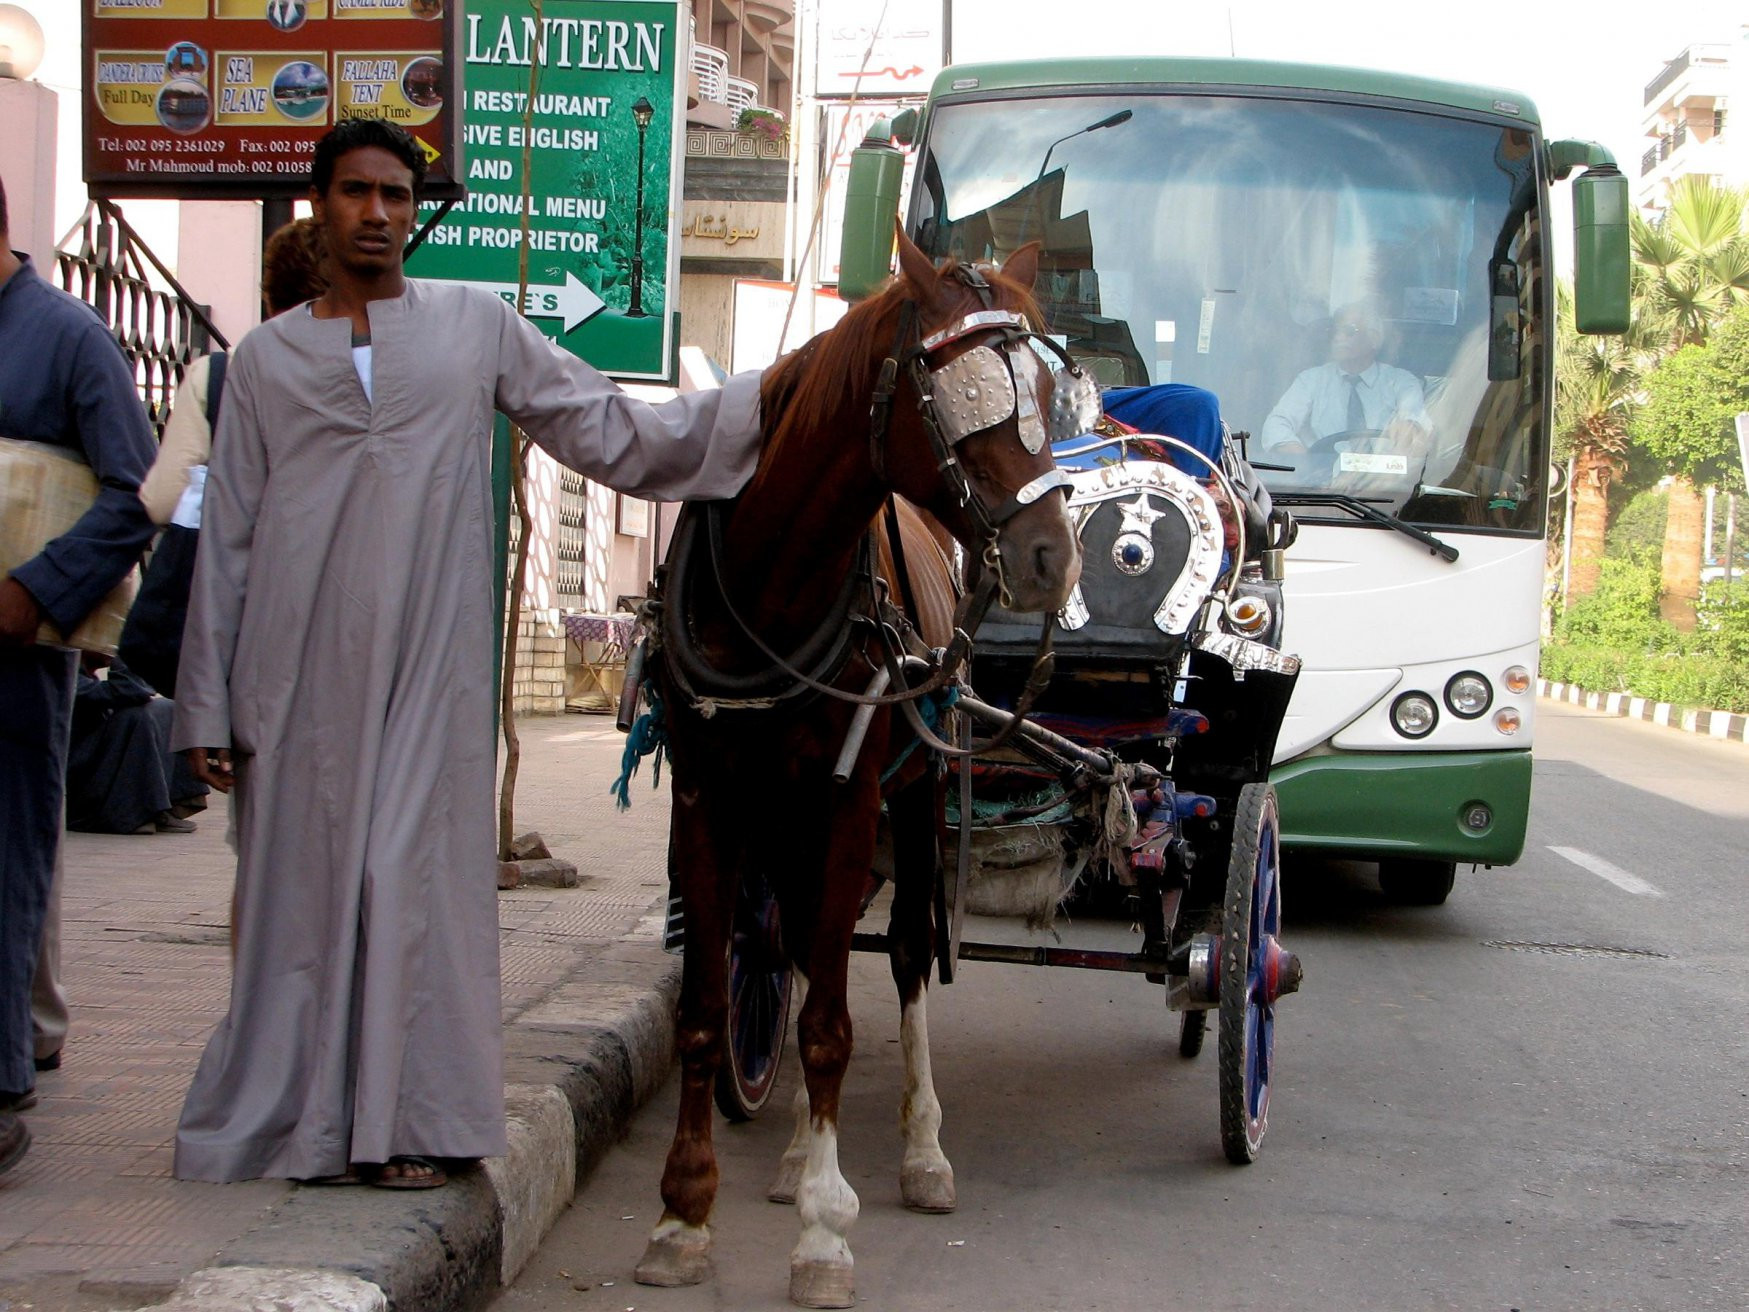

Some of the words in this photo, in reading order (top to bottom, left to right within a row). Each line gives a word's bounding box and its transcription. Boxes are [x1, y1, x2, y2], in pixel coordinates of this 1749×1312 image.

[465, 13, 665, 72] LANTERN
[225, 57, 253, 83] SEA
[342, 60, 398, 81] FALLAHA
[103, 90, 127, 104] Full
[131, 90, 153, 107] Day
[221, 88, 267, 113] PLANE
[351, 84, 383, 104] TENT
[474, 91, 611, 117] RESTAURANT
[342, 105, 379, 119] Sunset
[383, 105, 411, 118] Time
[98, 138, 124, 151] Tel:
[126, 140, 146, 152] 002
[151, 140, 171, 152] 095
[175, 140, 225, 152] 2361029
[240, 139, 267, 152] Fax:
[270, 140, 291, 152] 002
[295, 141, 315, 153] 095
[508, 126, 598, 151] ENGLISH
[127, 159, 146, 172] Mr
[150, 159, 214, 173] Mahmoud
[218, 159, 249, 173] mob:
[252, 161, 273, 173] 002
[469, 160, 513, 180] AND
[546, 198, 606, 220] MENU
[468, 227, 599, 253] PROPRIETOR
